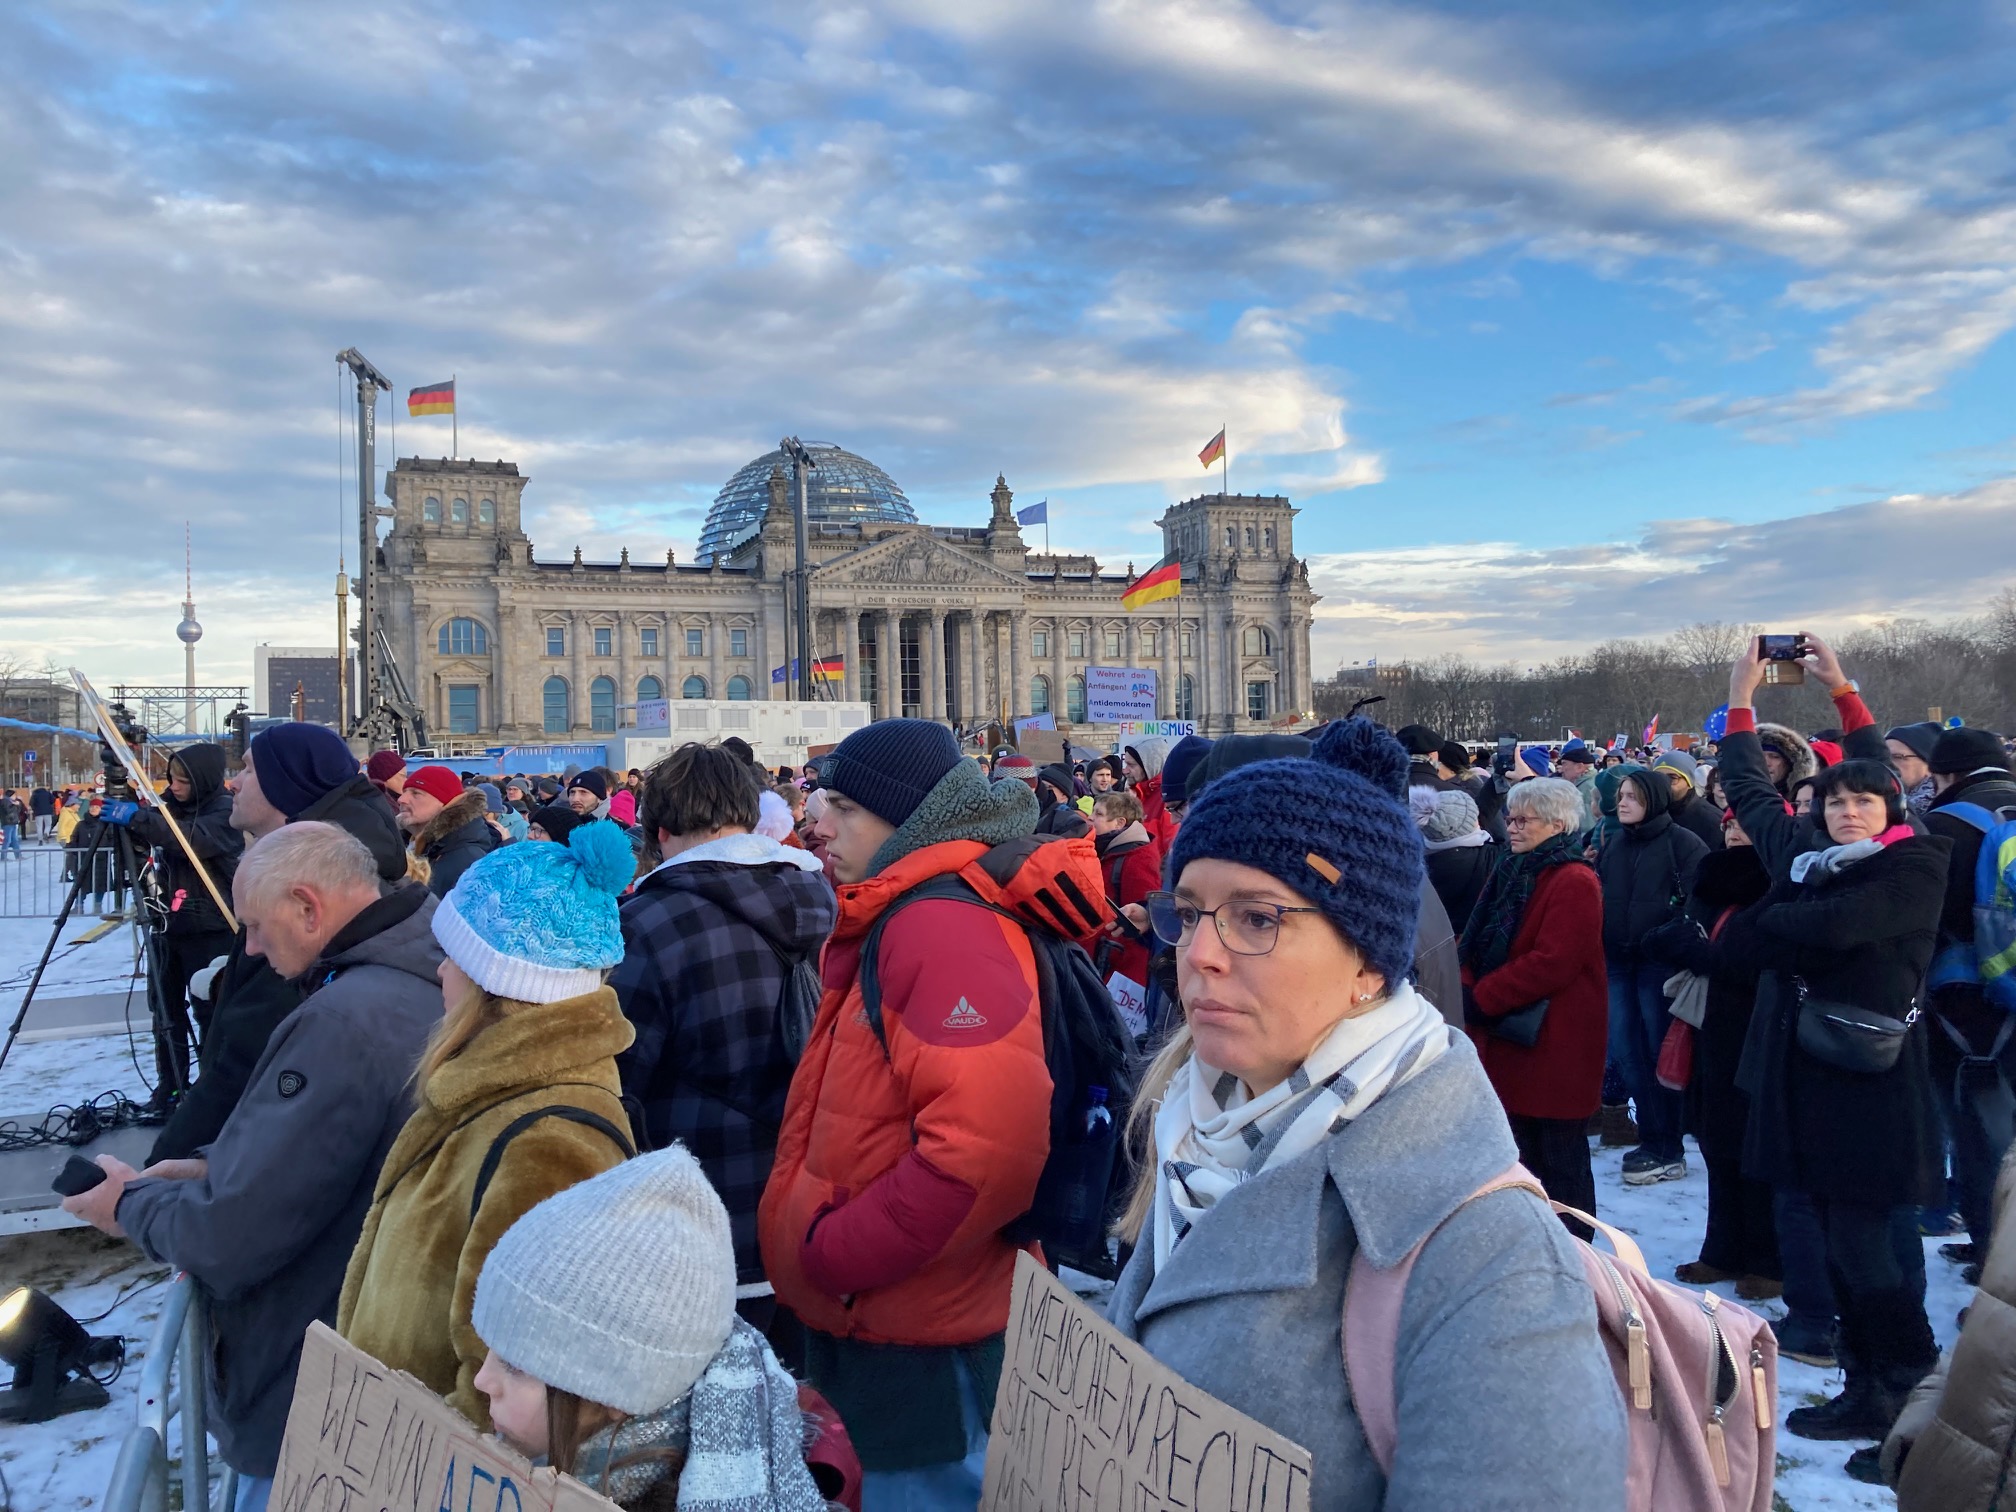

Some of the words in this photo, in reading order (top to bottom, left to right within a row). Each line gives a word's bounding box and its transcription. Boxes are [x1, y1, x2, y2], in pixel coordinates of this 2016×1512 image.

[1096, 670, 1125, 678] Wehret
[1088, 699, 1151, 708] Antidemokraten
[1108, 712, 1143, 720] Diktatur!
[1120, 722, 1194, 736] FEMINISMUS
[947, 1016, 983, 1025] VAUDE
[1000, 1367, 1061, 1485] STATT
[320, 1353, 437, 1511] WENN
